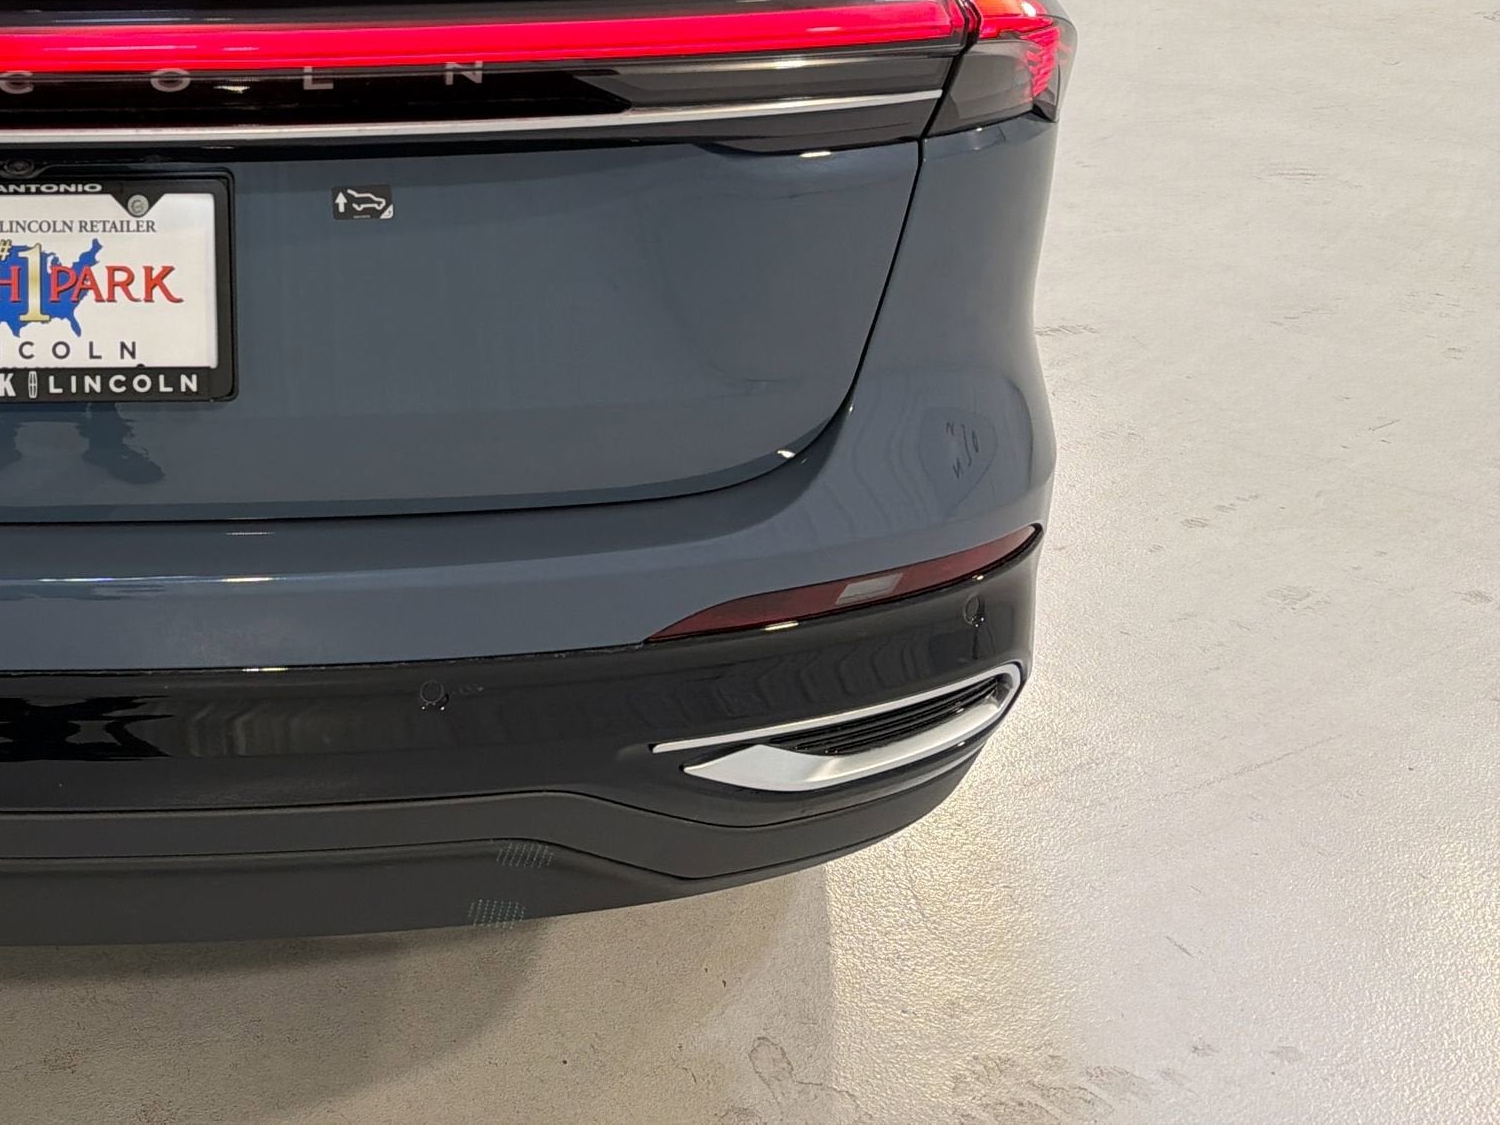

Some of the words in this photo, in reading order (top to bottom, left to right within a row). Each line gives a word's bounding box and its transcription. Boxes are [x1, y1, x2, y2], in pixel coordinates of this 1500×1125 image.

[0, 219, 73, 233] LINCOLN
[79, 219, 157, 233] RETAILER
[50, 265, 185, 303] PARK
[48, 374, 198, 394] LINCOLN
